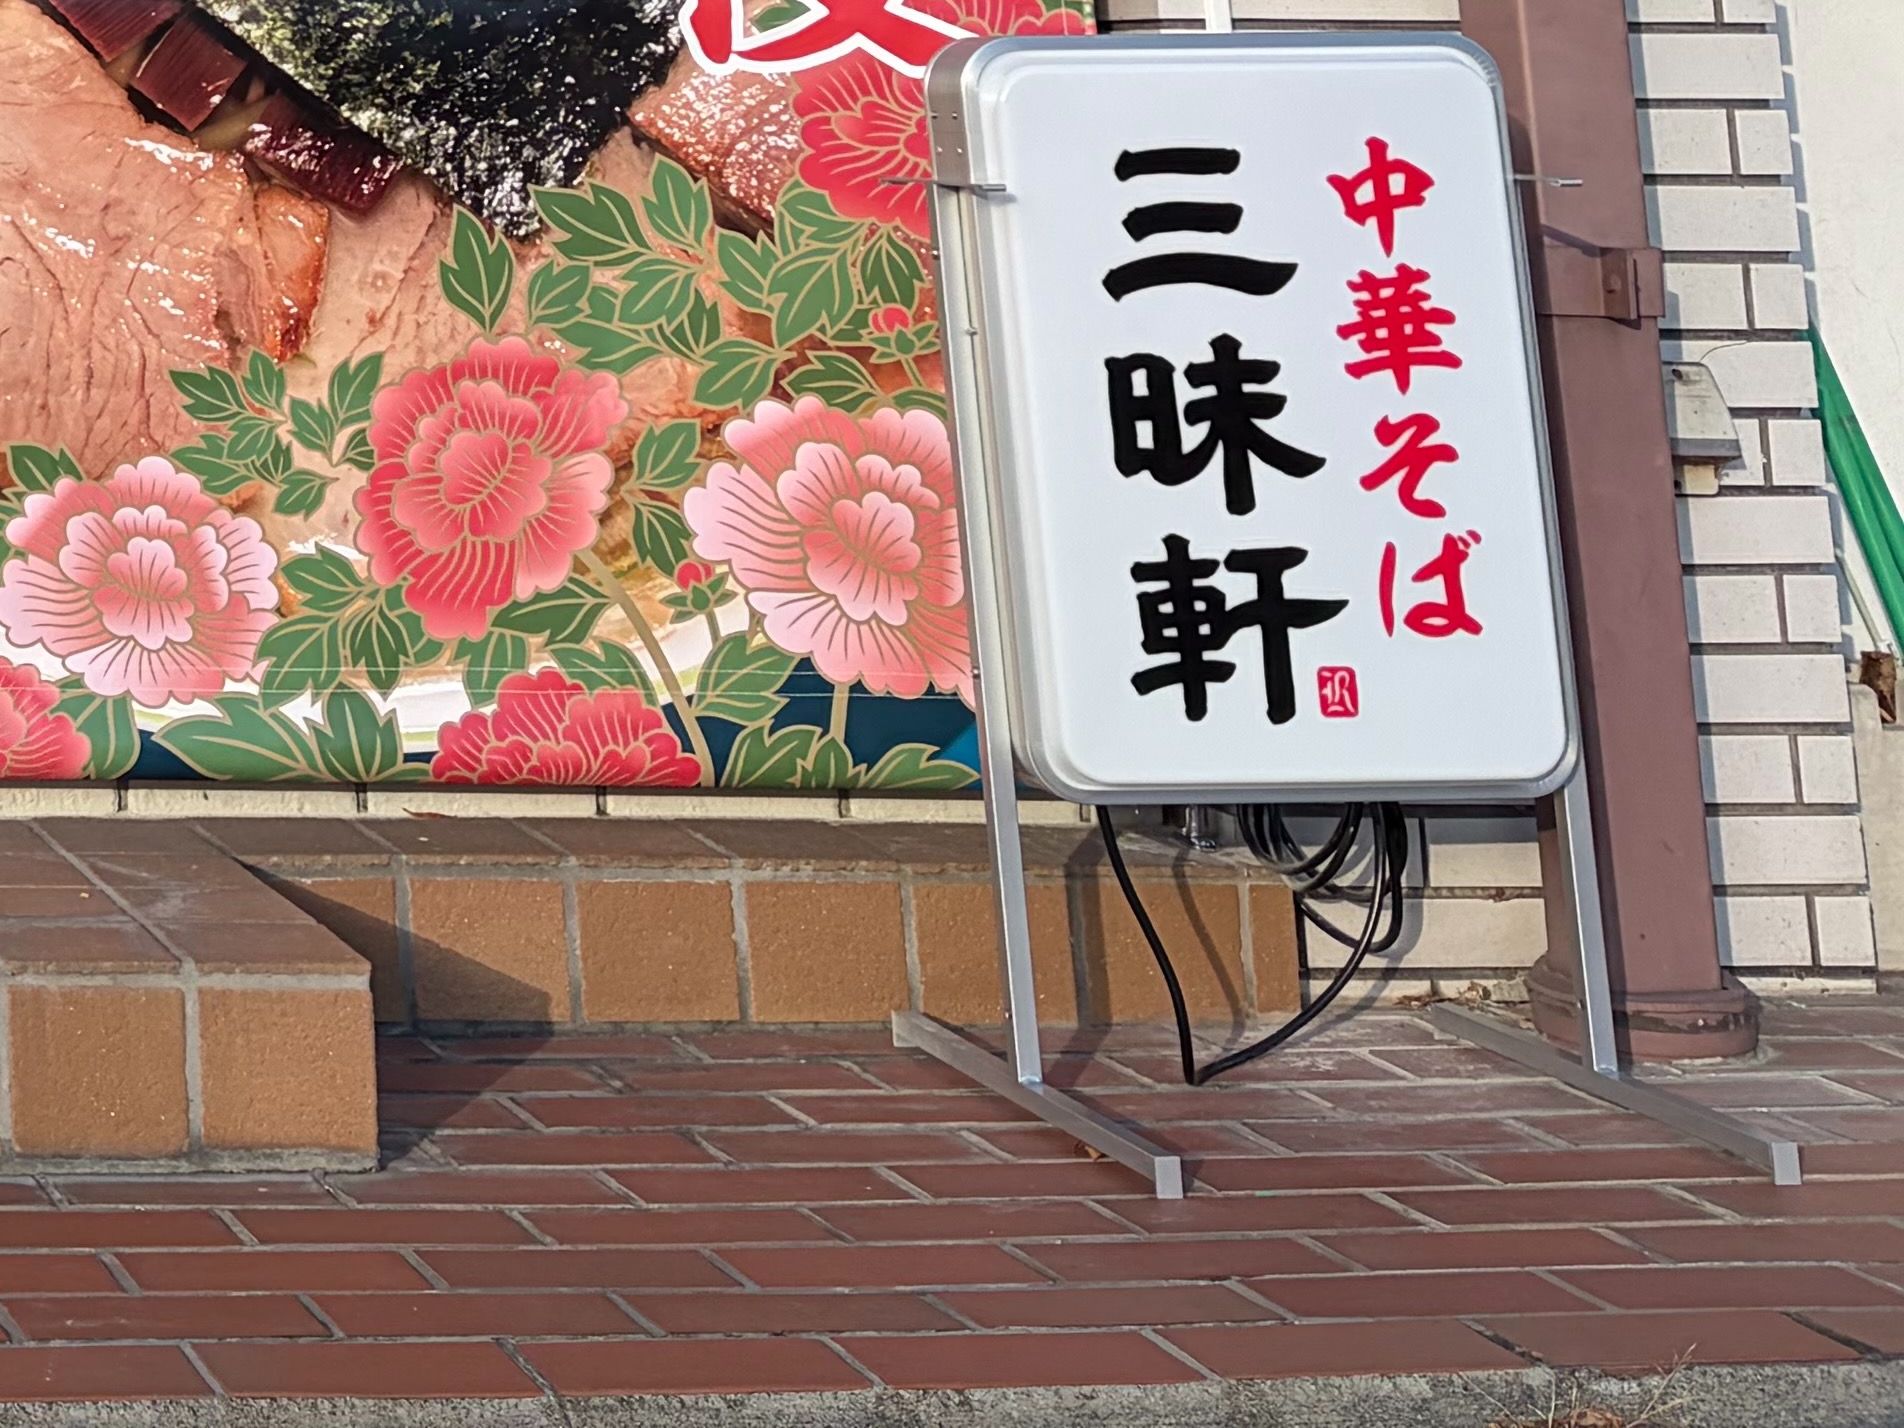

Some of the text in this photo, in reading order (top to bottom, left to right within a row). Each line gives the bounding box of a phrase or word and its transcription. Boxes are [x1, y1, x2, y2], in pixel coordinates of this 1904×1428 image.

[1102, 147, 1350, 724] 三昧軒
[1327, 136, 1483, 638] 中華そば
